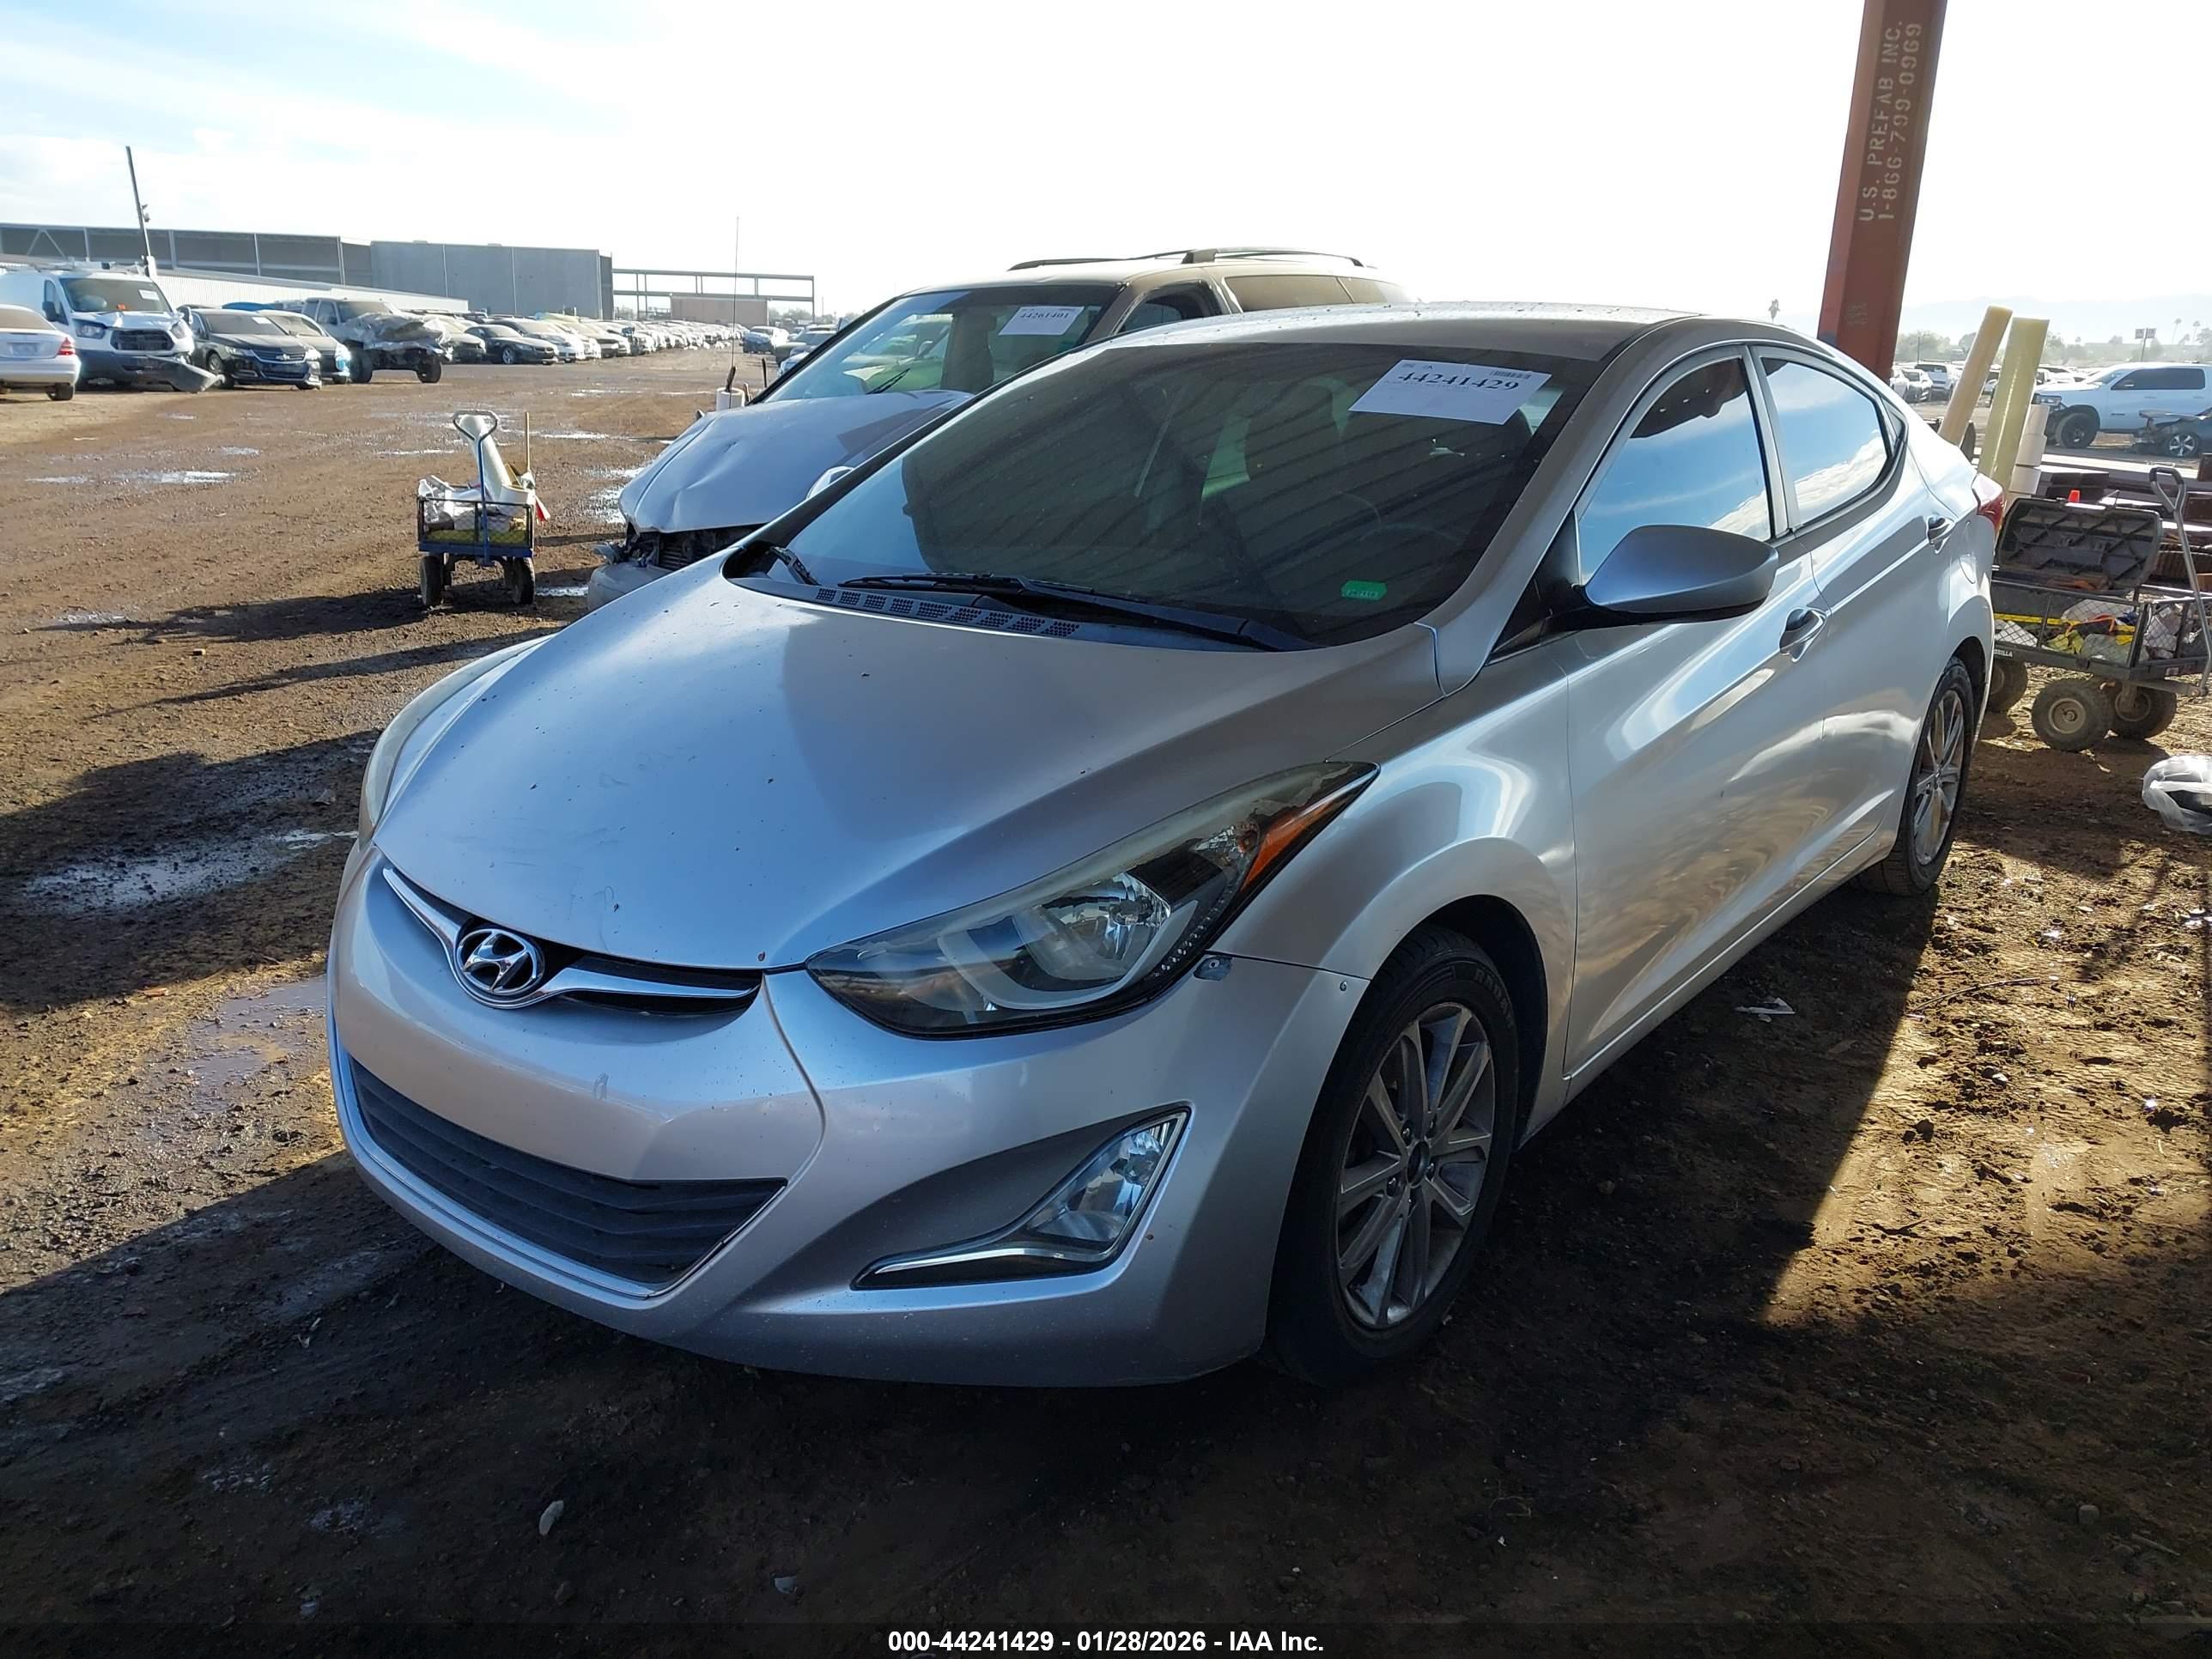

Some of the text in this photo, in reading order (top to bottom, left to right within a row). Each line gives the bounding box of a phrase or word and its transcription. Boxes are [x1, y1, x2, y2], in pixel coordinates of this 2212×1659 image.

[1858, 21, 1902, 222] U.S. PREFAB INC.
[1877, 22, 1923, 220] 1-866-799-0969
[1397, 371, 1520, 392] 44241429
